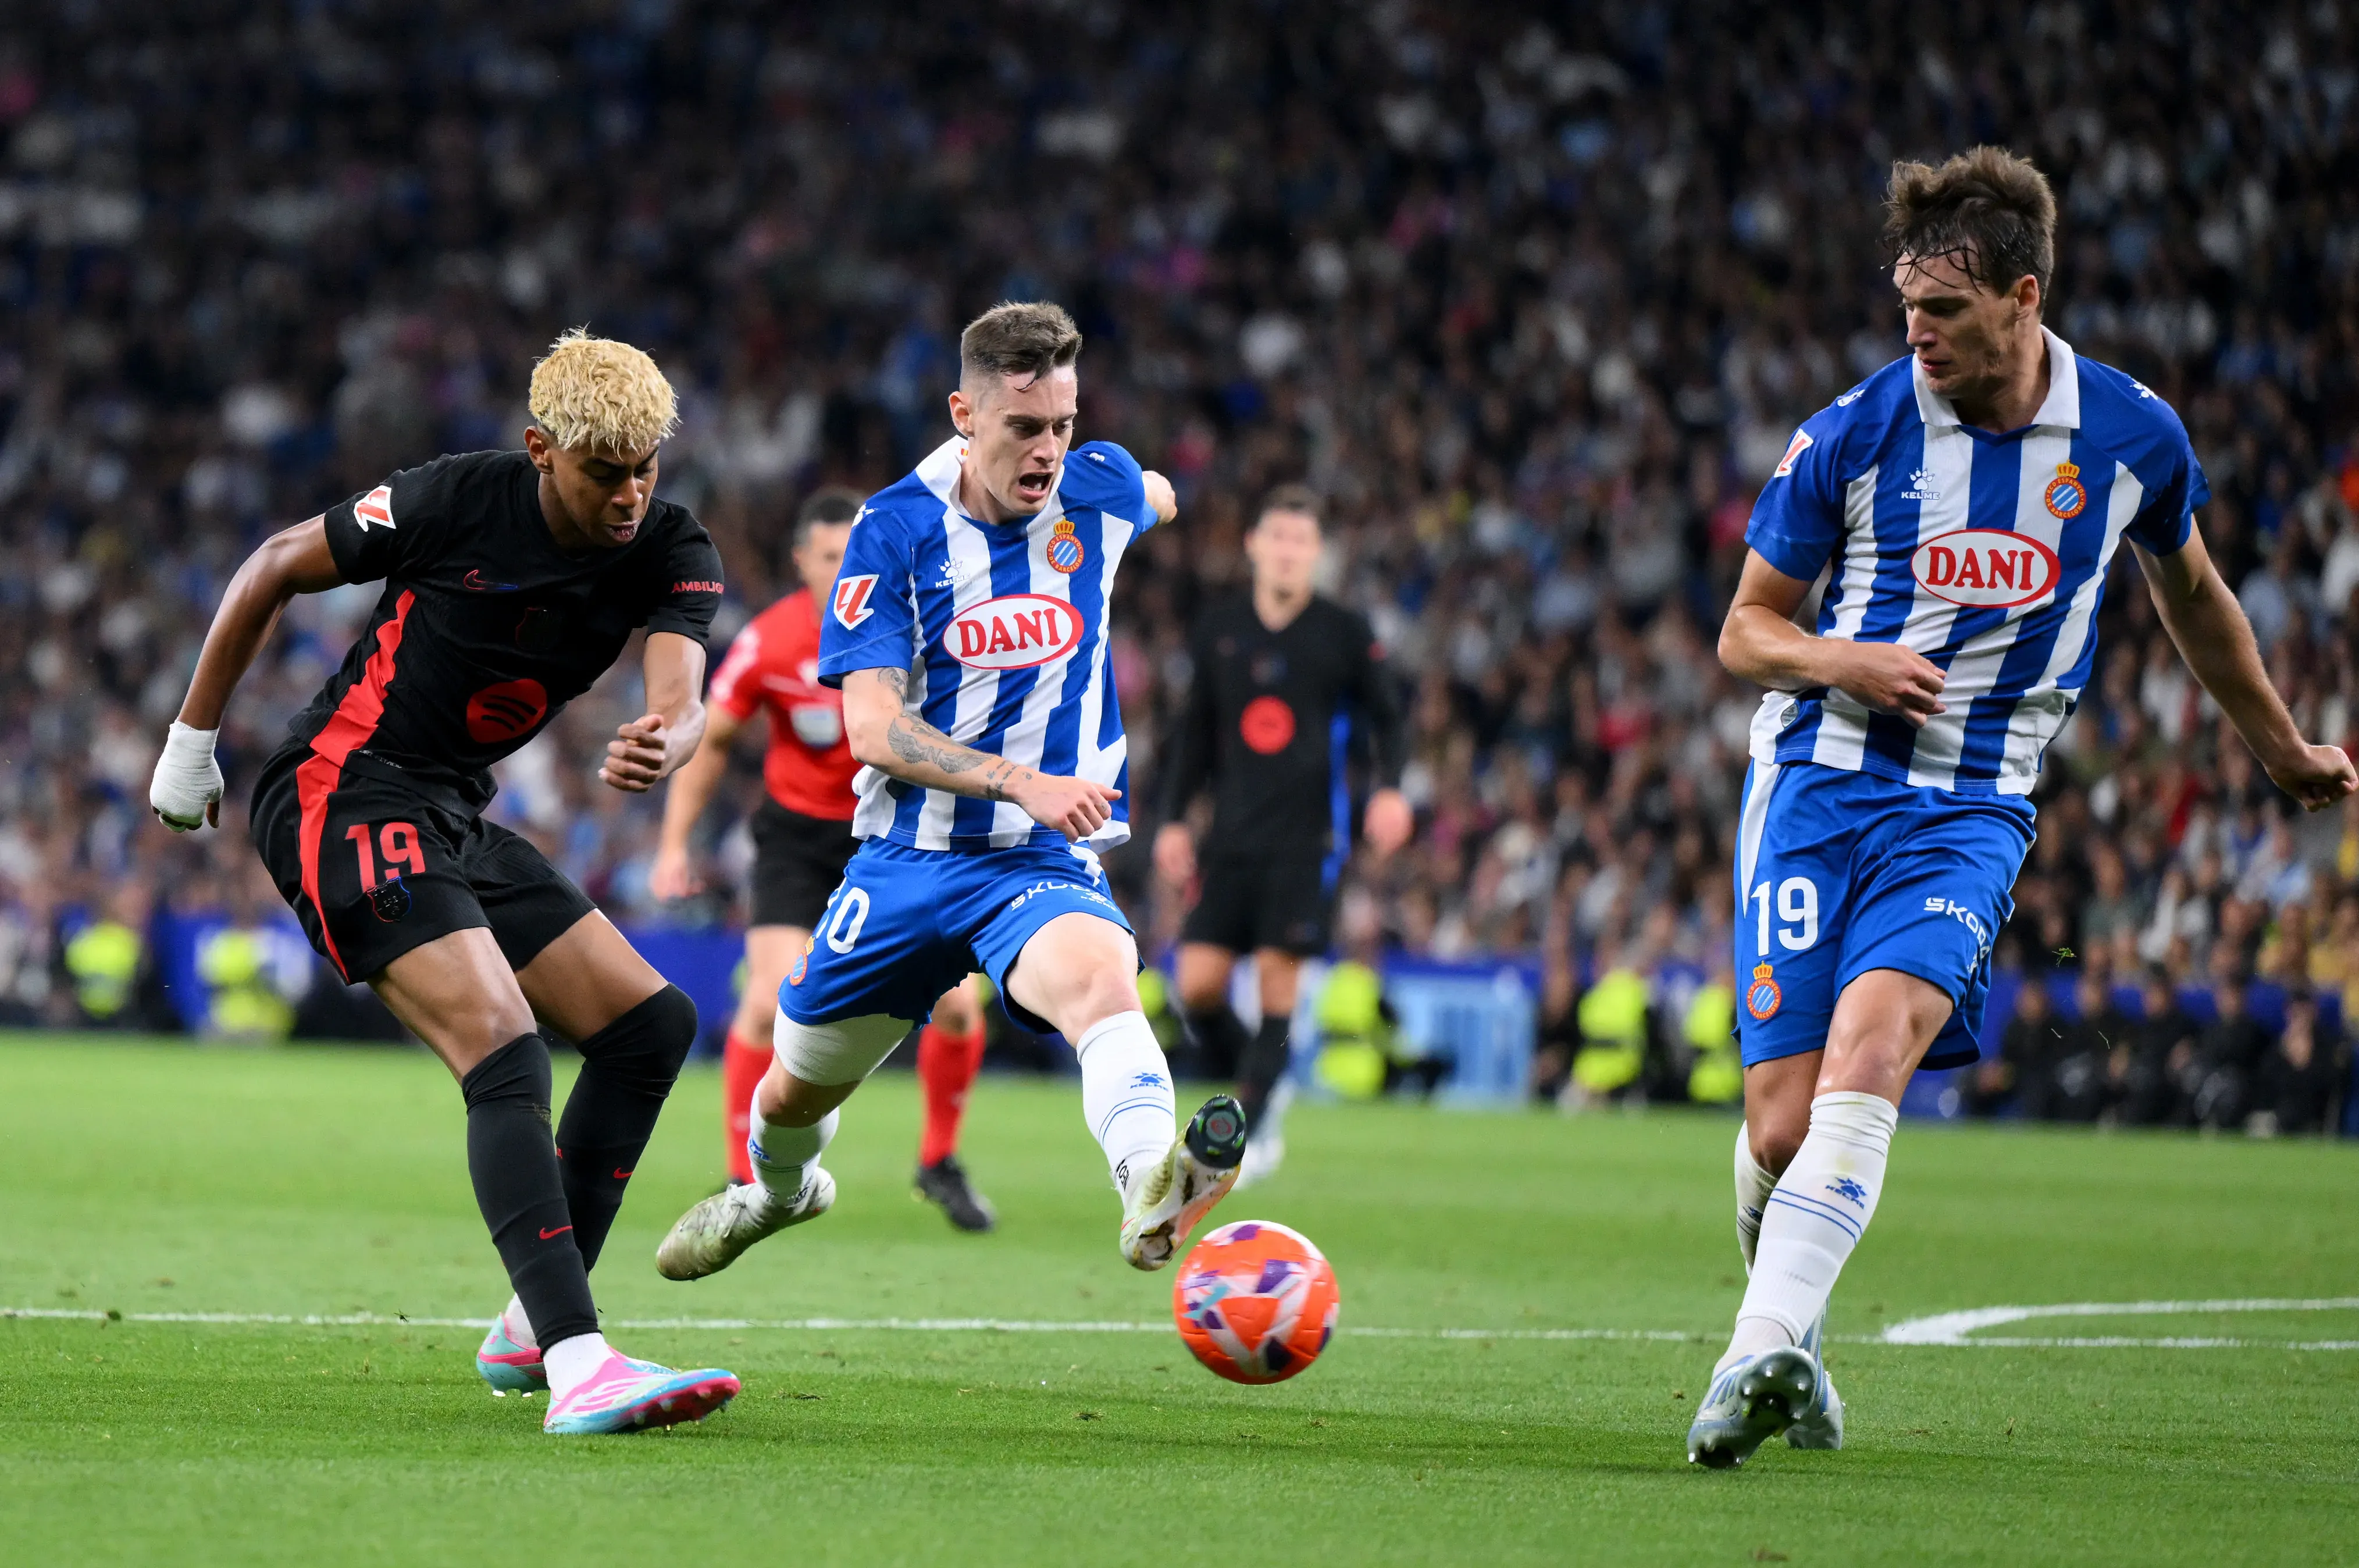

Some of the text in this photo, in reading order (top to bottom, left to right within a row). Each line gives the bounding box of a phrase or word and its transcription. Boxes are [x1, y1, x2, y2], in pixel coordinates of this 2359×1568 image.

[1901, 491, 1940, 500] KELME
[2047, 478, 2085, 497] RCD ESPANYOL
[2051, 501, 2085, 518] BARCELONA
[1056, 534, 1083, 550] ESPANYOL
[1049, 554, 1084, 572] DE BARCELONA
[1926, 546, 2035, 591] DANI
[957, 608, 1061, 658] DANI
[345, 822, 426, 893] 19
[1751, 876, 1818, 957] 19
